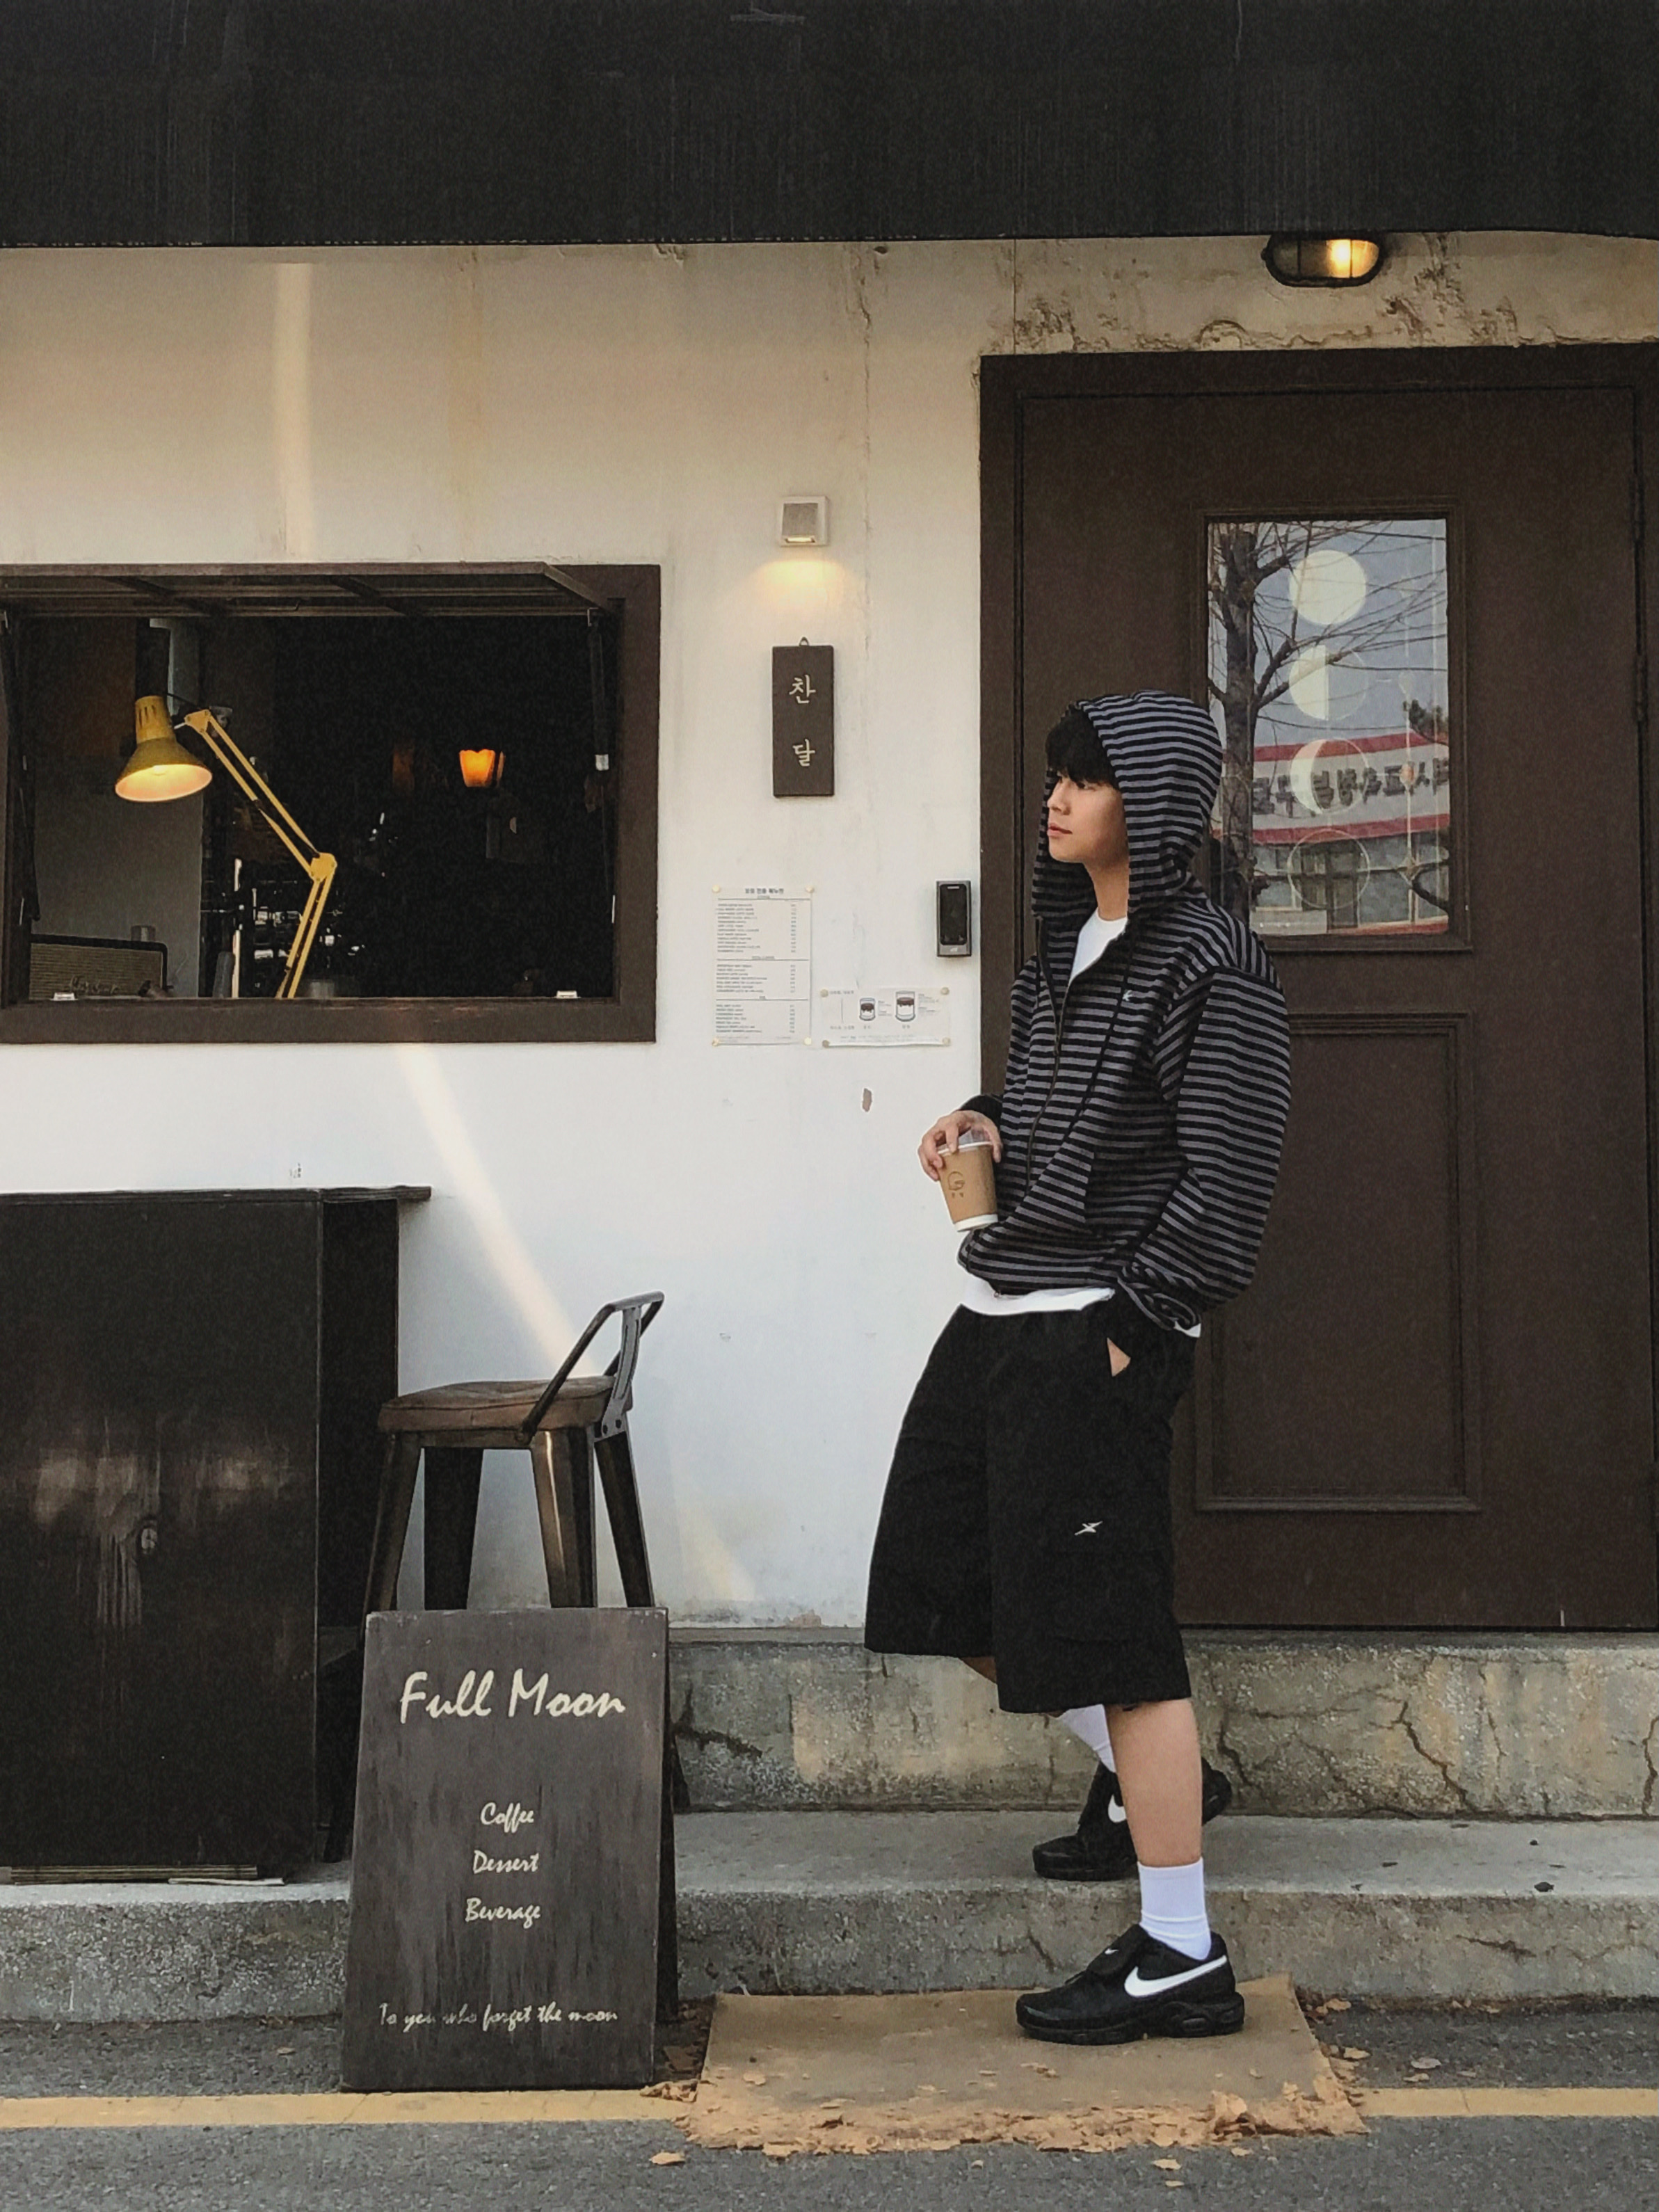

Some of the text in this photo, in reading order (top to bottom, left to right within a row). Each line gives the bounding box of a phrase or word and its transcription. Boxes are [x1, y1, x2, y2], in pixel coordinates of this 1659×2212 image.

[789, 674, 817, 767] 찬 달
[400, 1667, 626, 1724] Full Moon
[480, 1801, 535, 1834] Coffee
[472, 1849, 540, 1875] Dessert
[465, 1896, 541, 1930] Beverage
[379, 2002, 397, 2026] To
[403, 2012, 436, 2033] you
[483, 2003, 532, 2033] forget
[537, 2001, 562, 2023] the
[568, 2010, 618, 2023] moon
